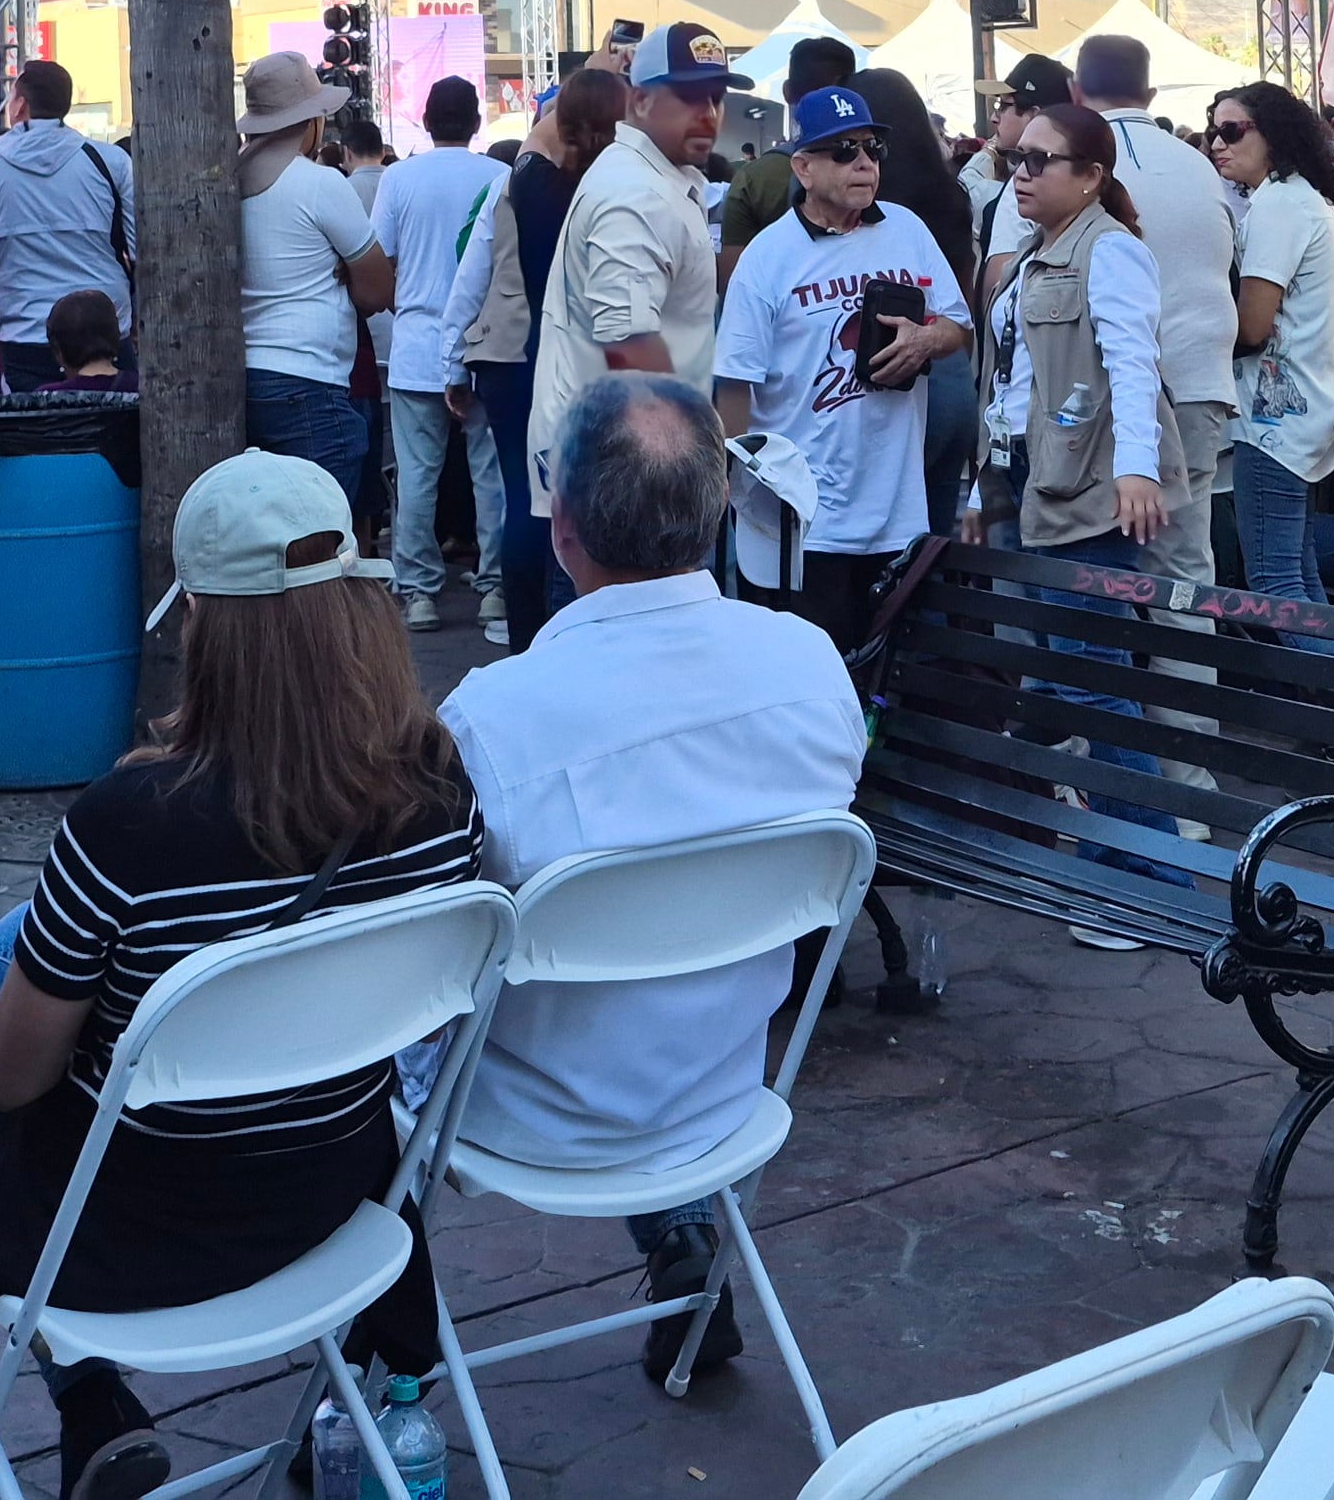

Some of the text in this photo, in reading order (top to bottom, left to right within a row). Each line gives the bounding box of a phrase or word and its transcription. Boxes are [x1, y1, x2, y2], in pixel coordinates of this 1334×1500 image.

[418, 2, 474, 15] KING
[830, 94, 856, 118] LA
[841, 297, 864, 312] CO
